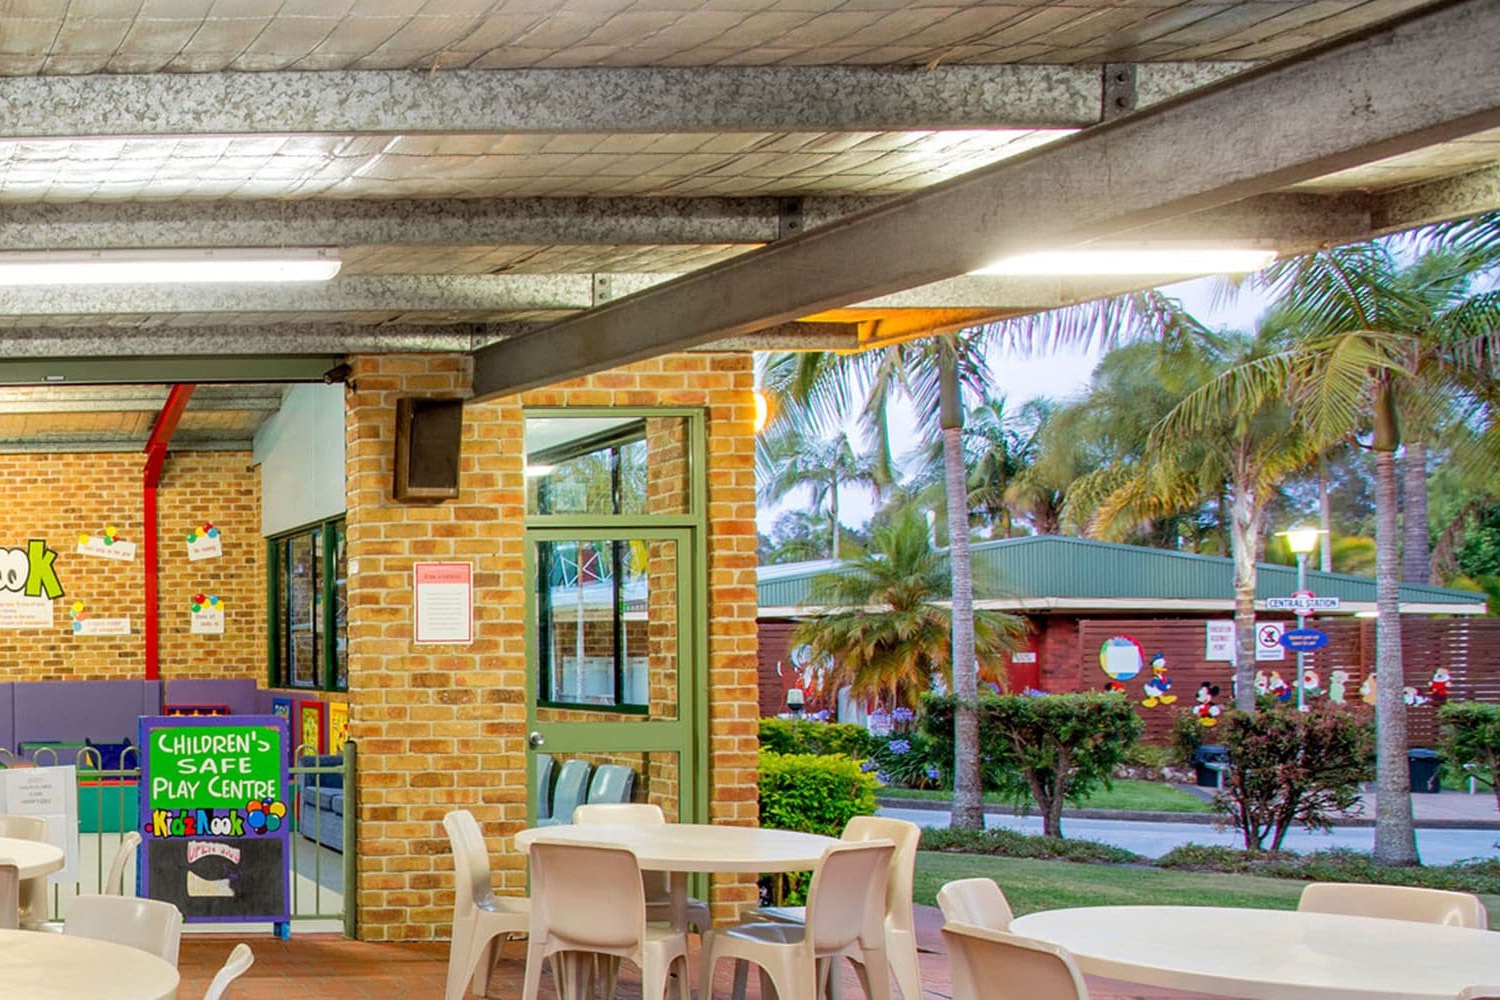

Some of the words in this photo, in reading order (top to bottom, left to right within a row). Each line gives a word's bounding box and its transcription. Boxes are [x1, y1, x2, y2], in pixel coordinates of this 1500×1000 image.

[1269, 599, 1304, 608] CENTRAL
[1306, 598, 1337, 607] STATION
[177, 757, 252, 774] SAFE
[153, 777, 200, 800] PLAY
[208, 775, 276, 799] CENTRE
